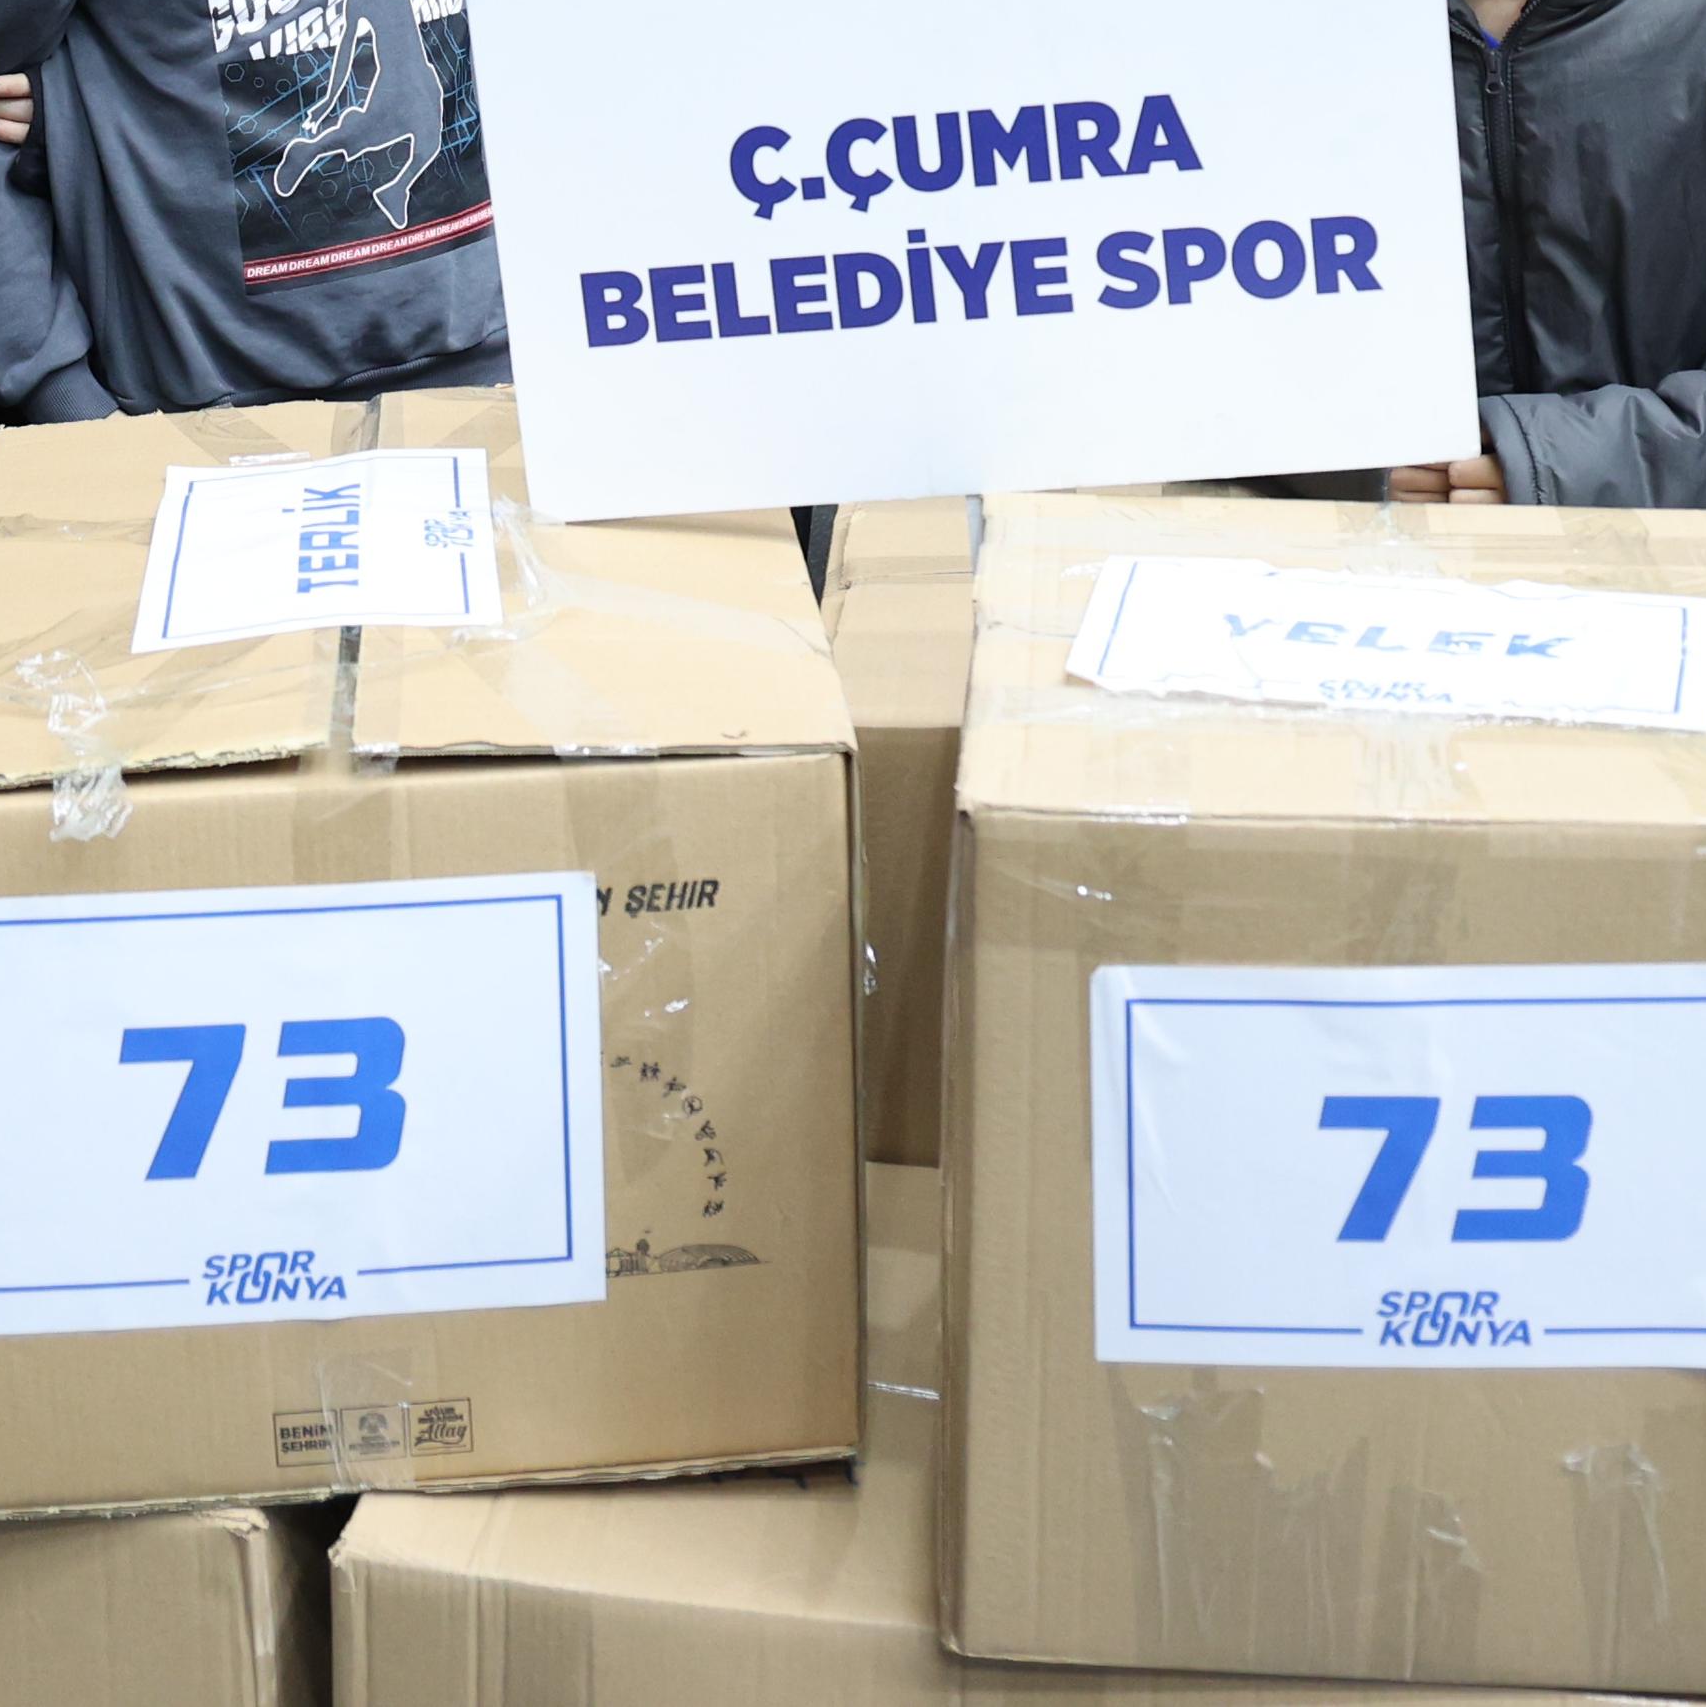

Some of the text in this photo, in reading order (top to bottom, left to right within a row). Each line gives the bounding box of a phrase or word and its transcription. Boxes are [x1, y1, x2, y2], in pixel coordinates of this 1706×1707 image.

[730, 94, 1203, 220] Ç.ÇUMRA
[247, 264, 287, 278] DREAM
[289, 256, 330, 271] DREAM
[331, 247, 371, 263] DREAM
[371, 237, 407, 253] DREAM
[408, 228, 437, 244] DREAM
[579, 215, 1382, 347] BELEDİYE SPOR
[281, 483, 361, 594] TERLİK
[1223, 612, 1575, 659] YELEK
[119, 1016, 406, 1181] 73
[1319, 1095, 1593, 1243] 73
[202, 1250, 316, 1283] SPOR
[205, 1270, 347, 1306] KONYA
[1377, 1291, 1500, 1323] SPOR
[1379, 1311, 1532, 1347] KONYA
